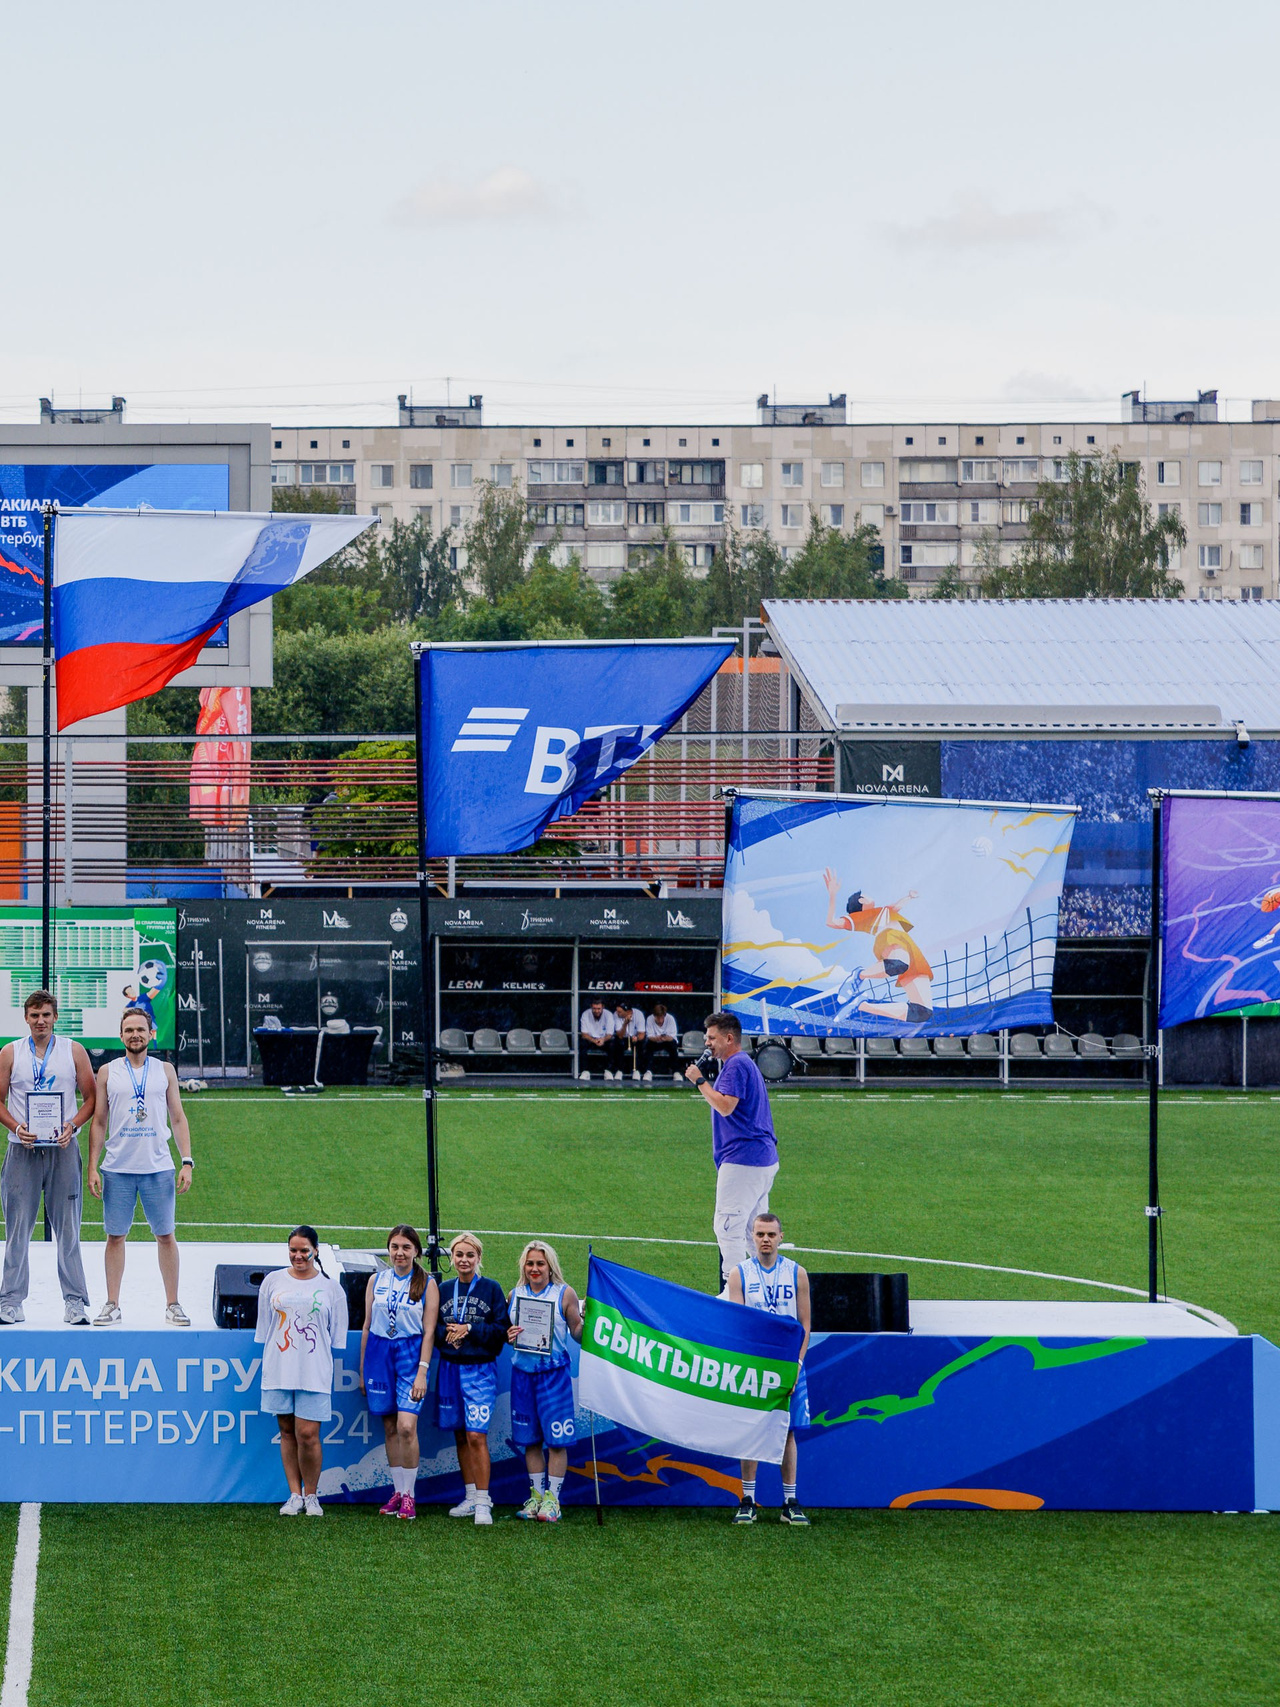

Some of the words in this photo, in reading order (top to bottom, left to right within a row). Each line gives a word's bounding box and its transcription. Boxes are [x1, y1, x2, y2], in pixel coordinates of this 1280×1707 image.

[0, 516, 28, 528] ВТБ
[856, 785, 888, 793] NOVA
[890, 785, 929, 793] ARENA
[593, 1316, 781, 1399] СЫКТЫВКАР
[551, 1418, 574, 1438] 96
